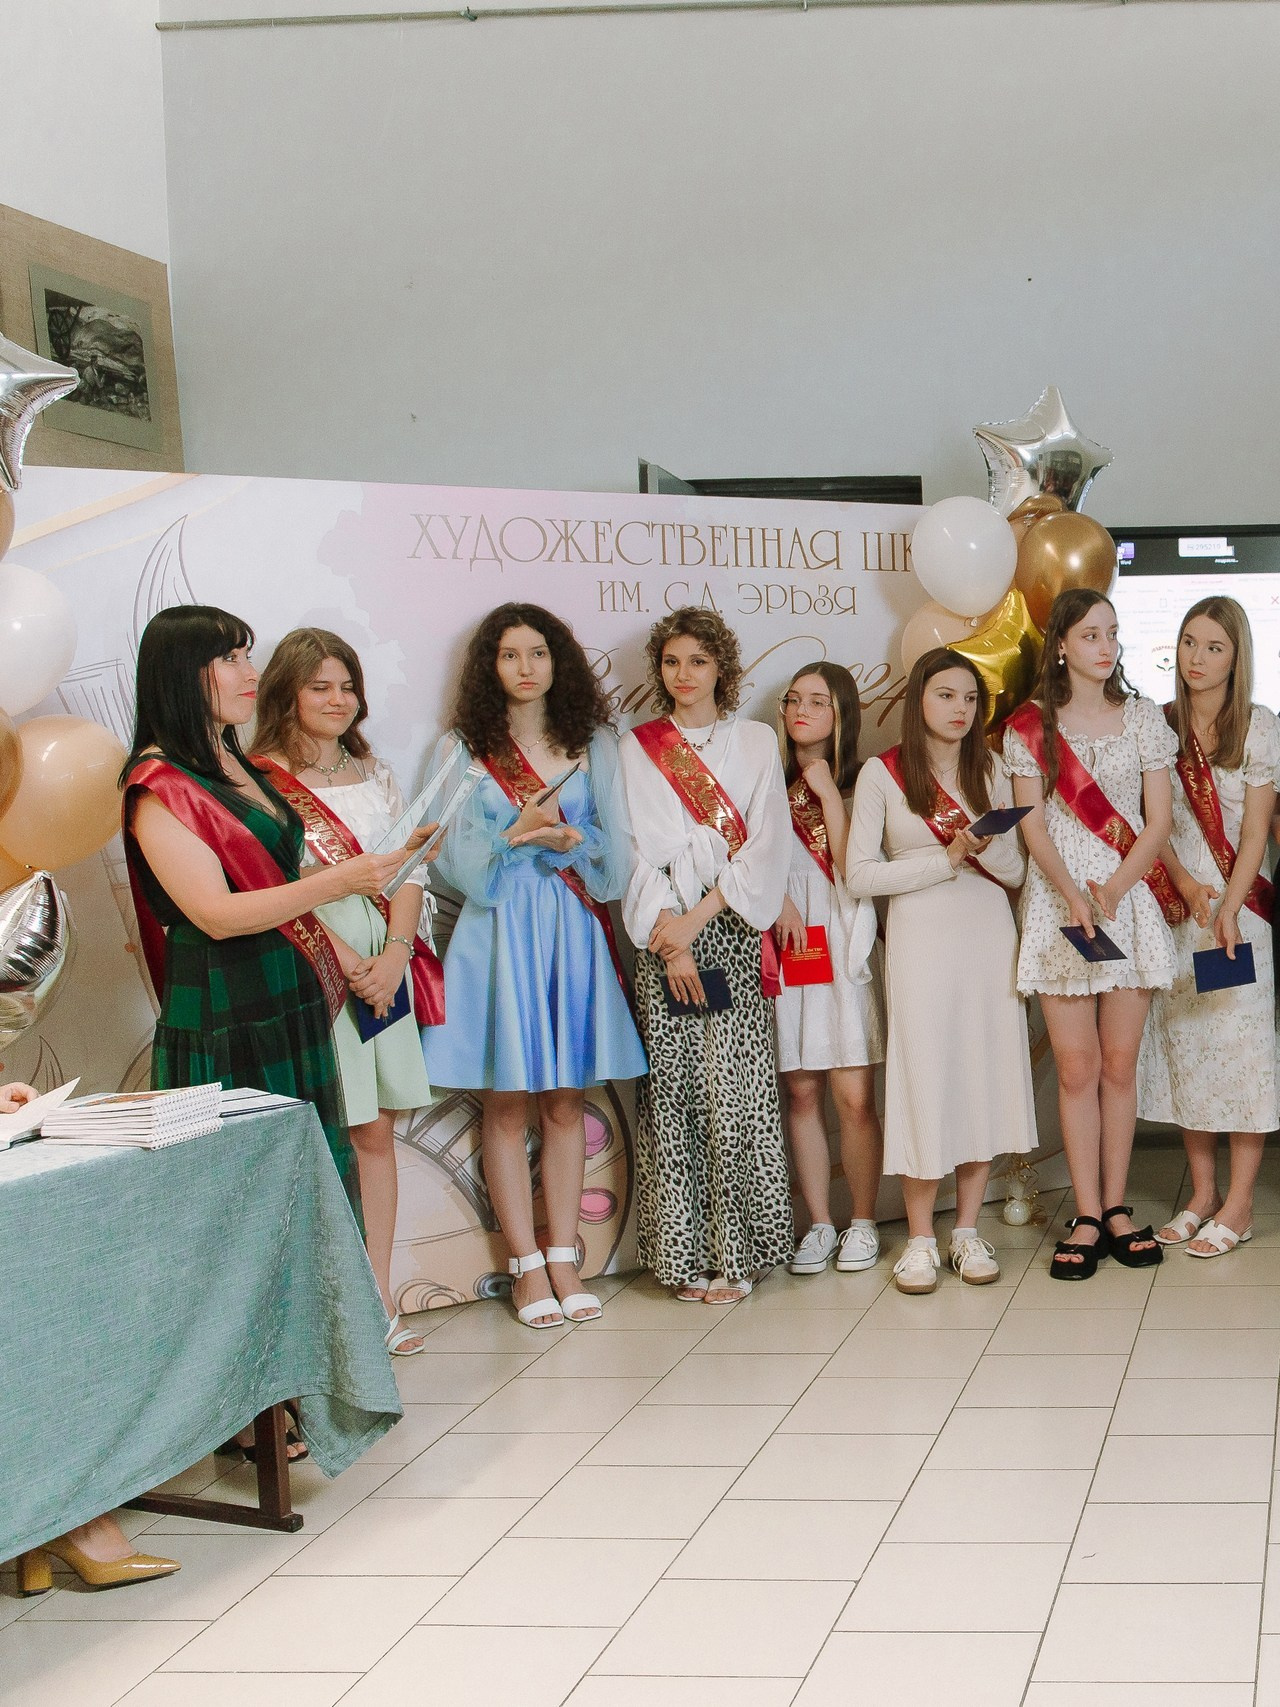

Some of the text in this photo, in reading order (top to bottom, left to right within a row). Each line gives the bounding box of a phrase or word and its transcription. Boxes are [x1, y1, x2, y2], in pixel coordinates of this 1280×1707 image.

[406, 513, 843, 572] ХУДОЖЕСТВЕННАЯ
[597, 580, 650, 613] ИМ.
[737, 582, 859, 616] ЭРЬЗЯ
